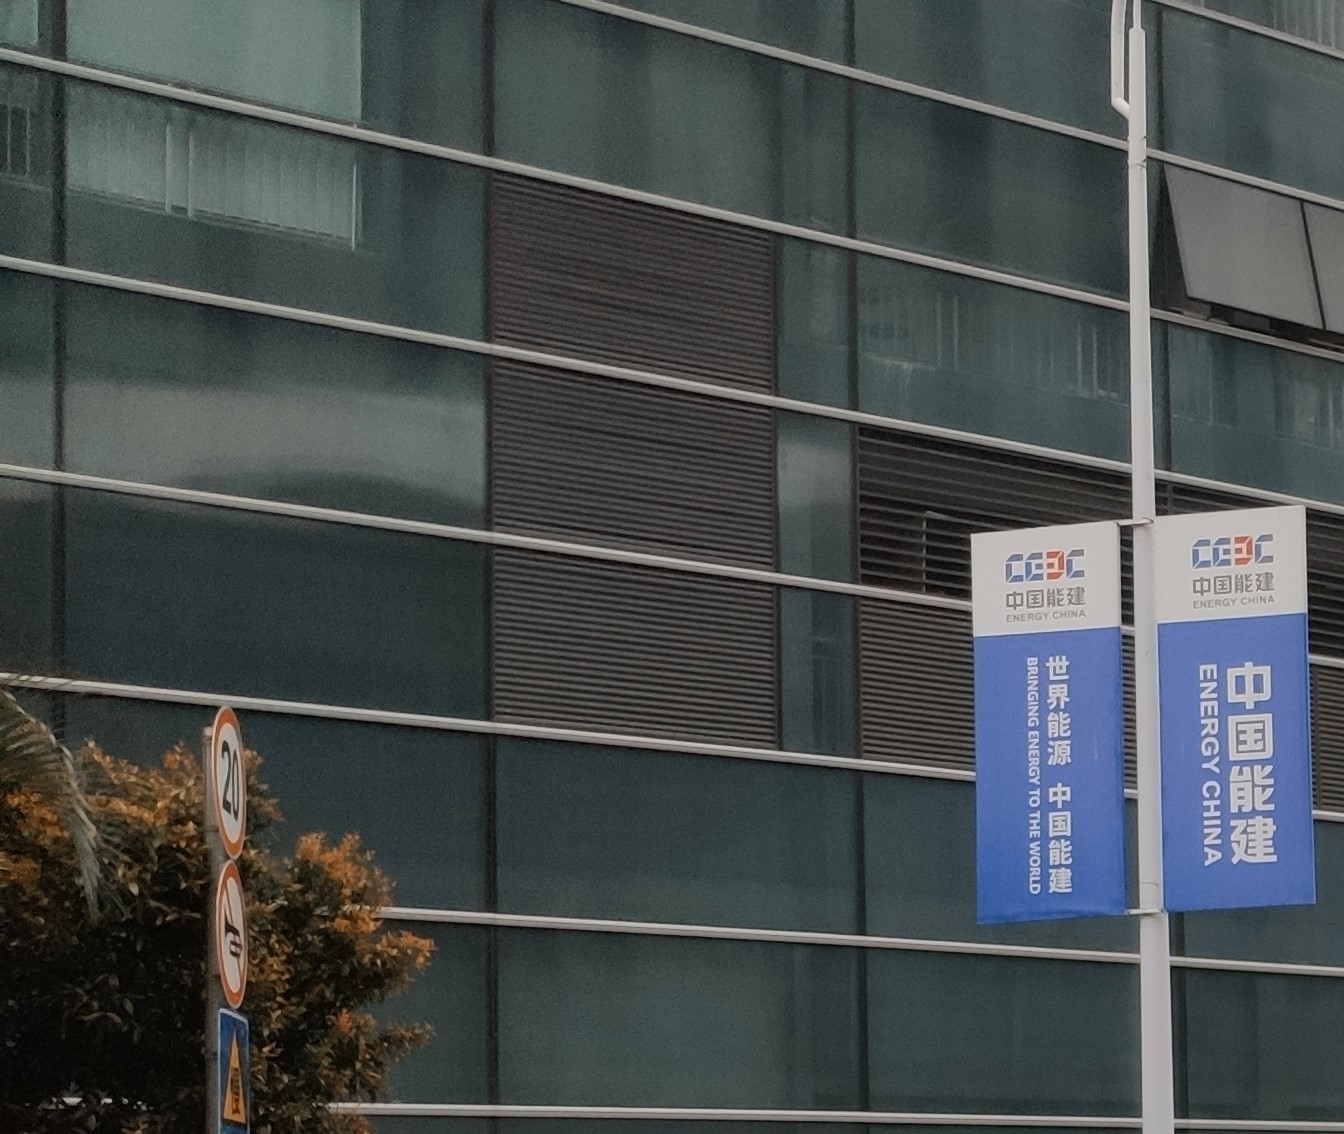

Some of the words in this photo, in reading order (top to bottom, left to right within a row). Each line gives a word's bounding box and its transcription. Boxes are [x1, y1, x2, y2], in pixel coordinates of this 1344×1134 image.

[1005, 586, 1087, 611] 中国能建
[1192, 571, 1275, 597] 中国能建
[1192, 598, 1238, 609] ENERGY
[1240, 595, 1276, 606] CHINA
[1005, 612, 1050, 623] ENERGY
[1052, 609, 1087, 620] CHINA
[1026, 656, 1039, 728] BRINGING
[1046, 655, 1072, 766] 世界能源
[1199, 663, 1221, 774] ENERGY
[221, 740, 240, 821] 20
[1028, 730, 1040, 785] ENERGY
[1226, 661, 1279, 866] 中国能建
[1028, 787, 1041, 808] TO
[1029, 810, 1041, 839] THE
[1202, 780, 1223, 867] CHINA
[1048, 782, 1073, 894] 中国能建
[1029, 840, 1042, 895] WORLD
